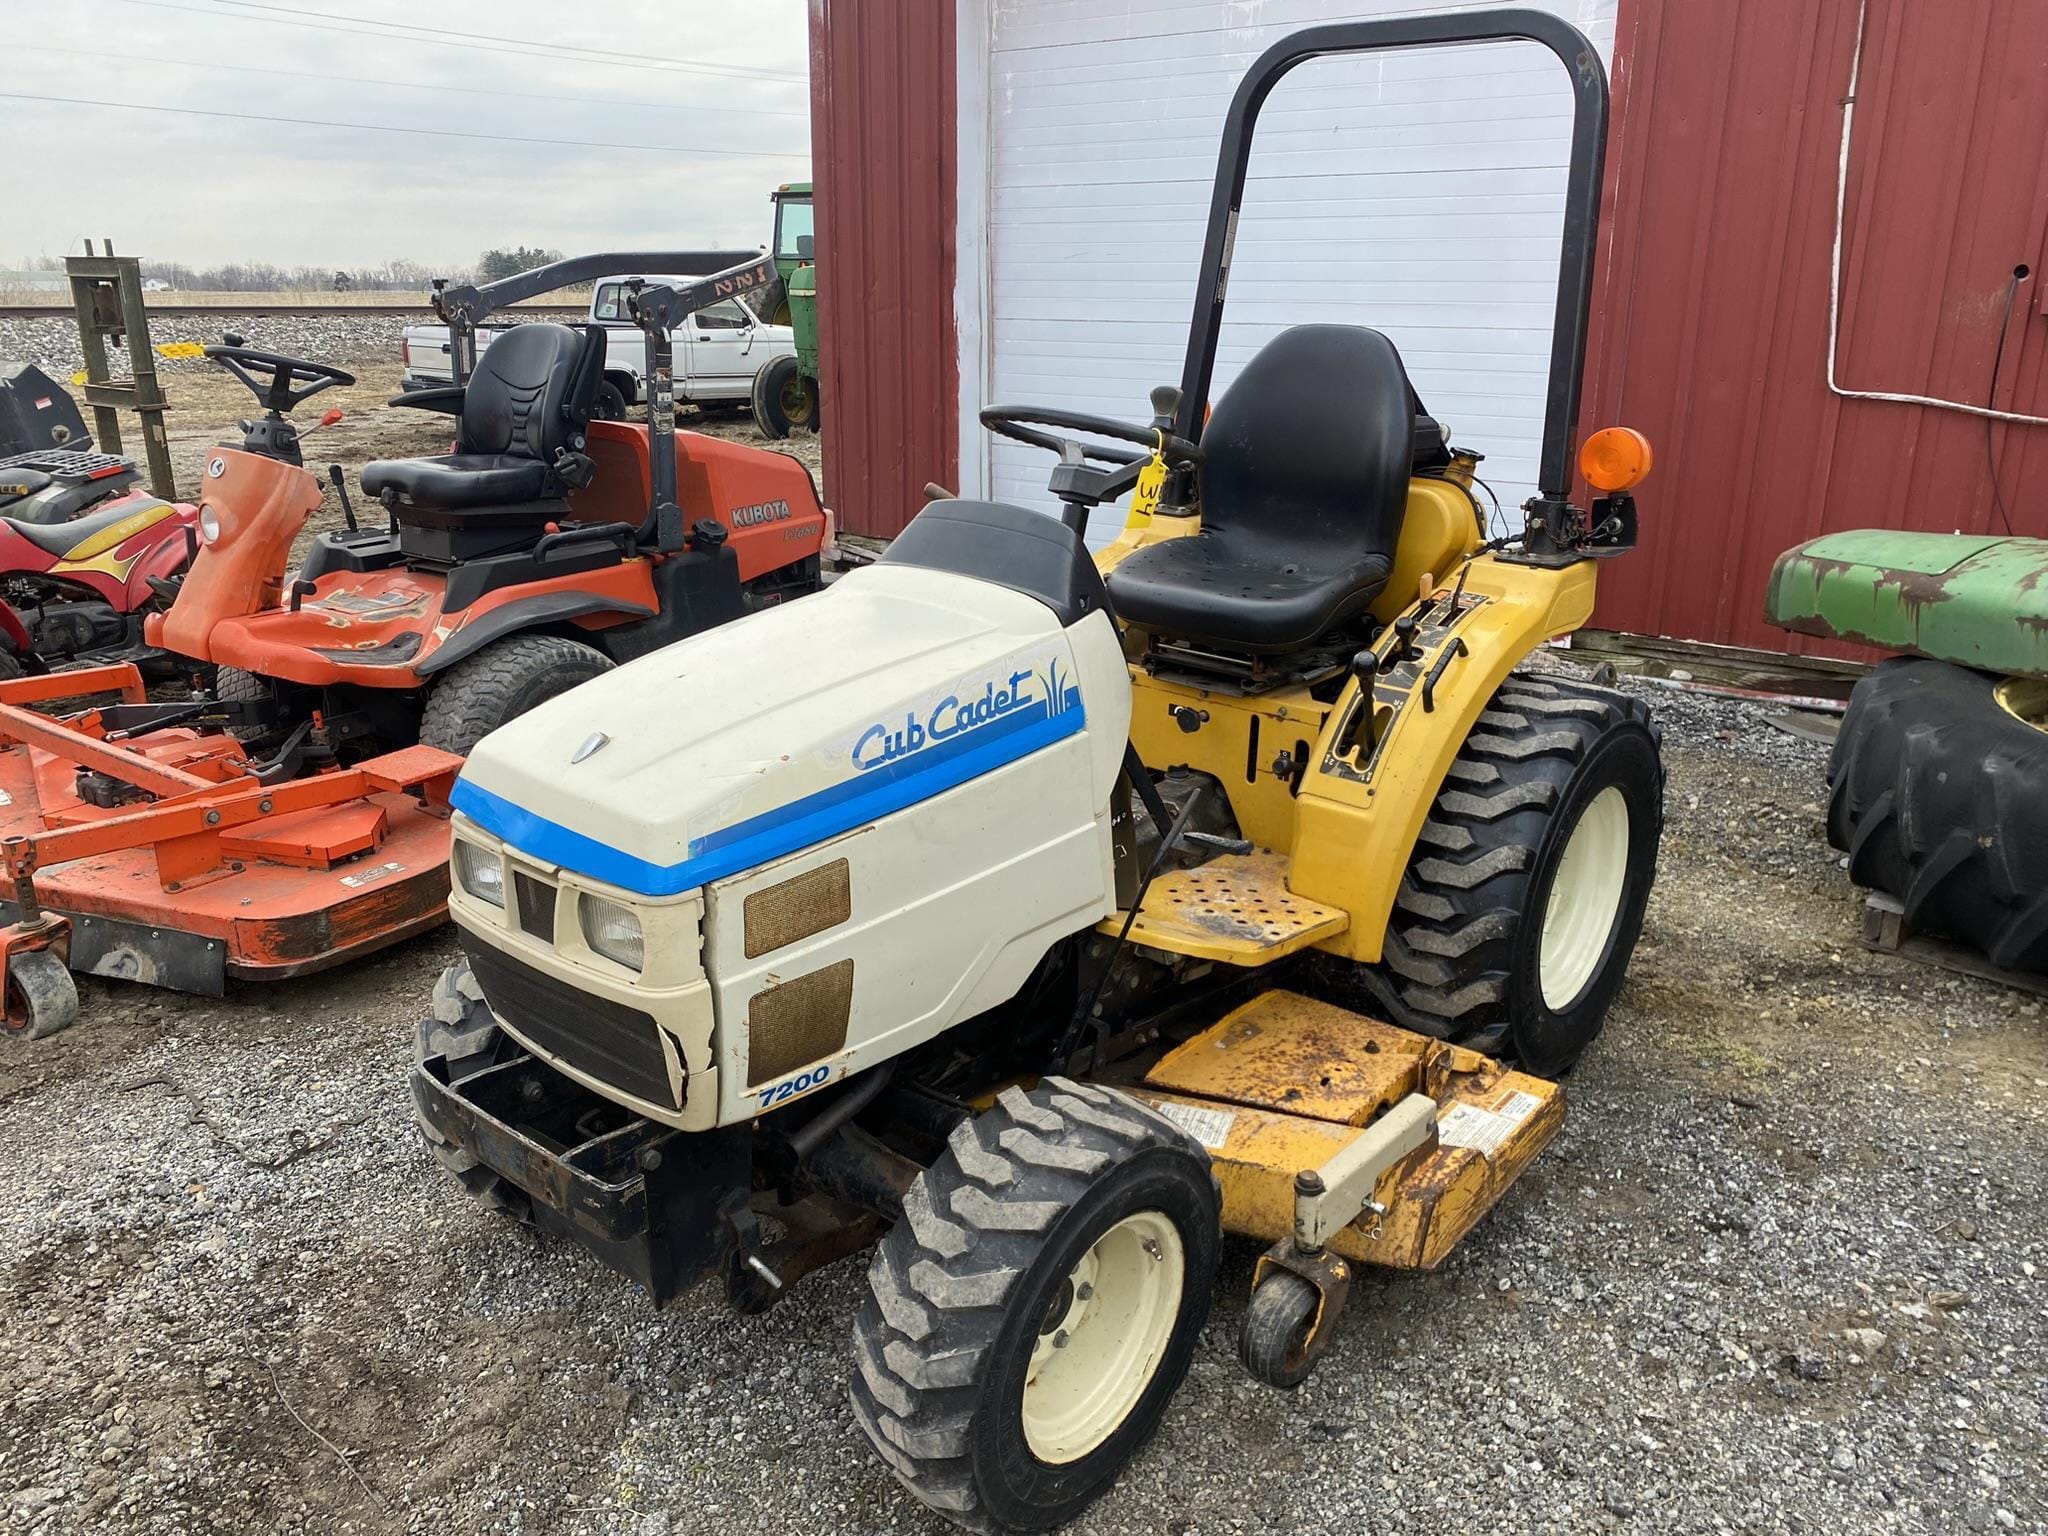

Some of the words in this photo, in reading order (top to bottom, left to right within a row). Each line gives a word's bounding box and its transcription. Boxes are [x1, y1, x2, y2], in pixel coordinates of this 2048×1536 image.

[731, 500, 791, 528] KUBOTA
[852, 712, 926, 770] Cub
[928, 669, 1033, 740] Cadet
[759, 1065, 830, 1108] 7200
